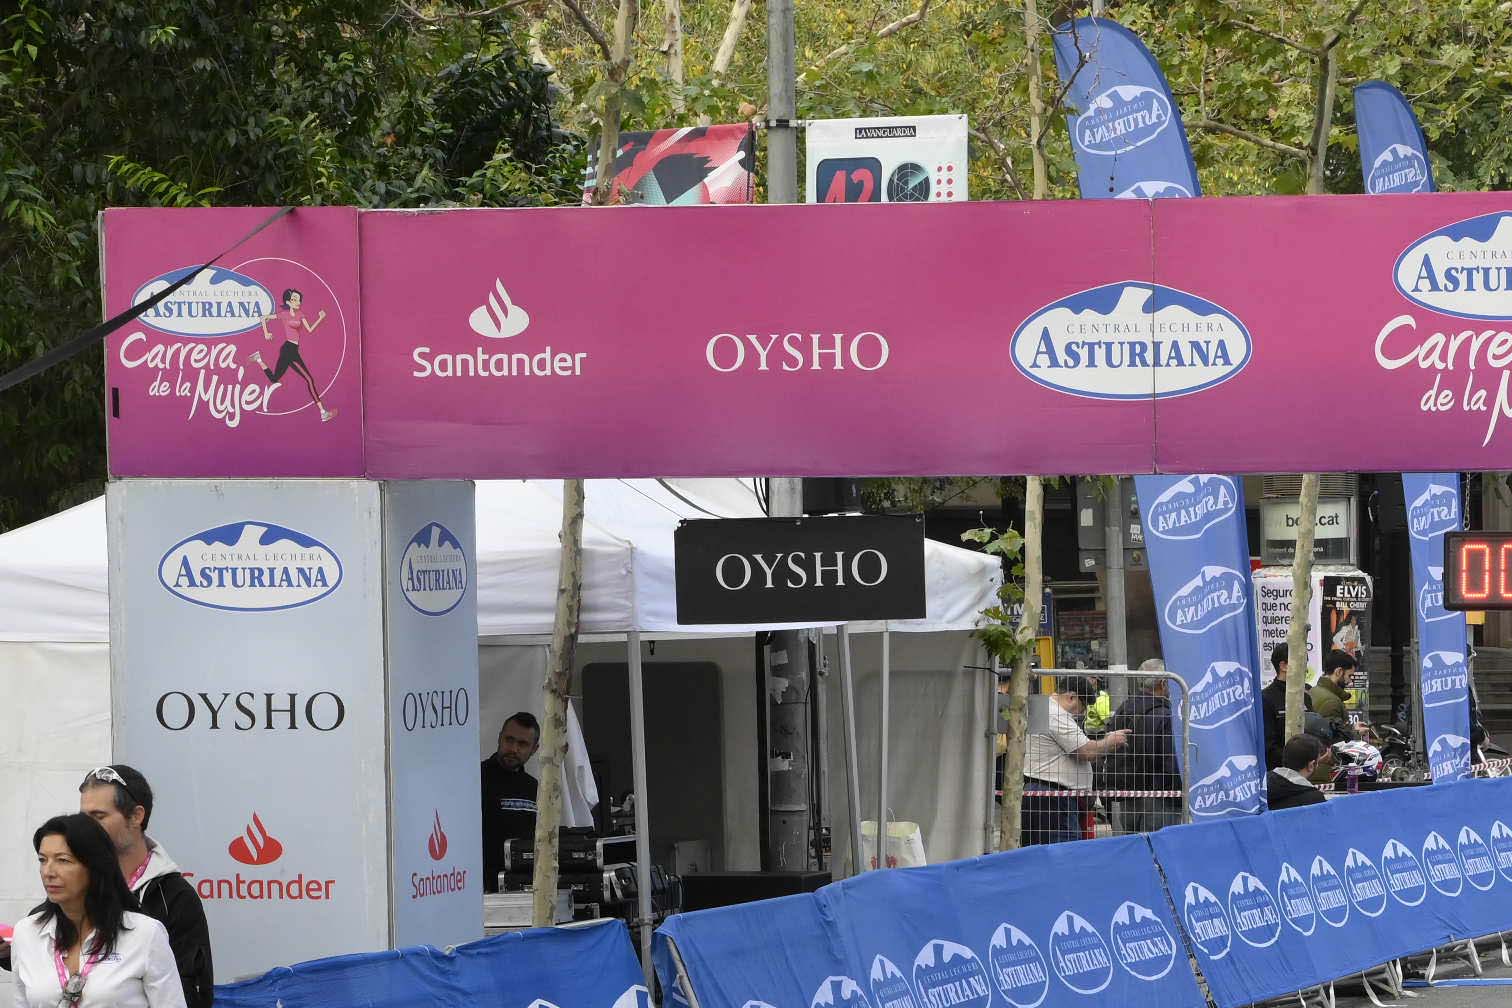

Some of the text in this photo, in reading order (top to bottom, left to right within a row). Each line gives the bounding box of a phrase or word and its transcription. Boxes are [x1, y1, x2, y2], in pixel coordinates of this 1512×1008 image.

[142, 291, 263, 318] ASTURIANA
[171, 288, 208, 298] ENTRAL
[1066, 321, 1225, 334] CENTRAL LECHERA
[120, 332, 236, 371] Carrera
[412, 346, 587, 377] Santander
[704, 332, 890, 372] OYSHO
[1029, 326, 1233, 369] ASTURIANA
[149, 364, 282, 428] de la Mujer
[1420, 373, 1455, 412] de
[1463, 372, 1487, 411] la
[1285, 513, 1340, 528] bc.cat
[172, 554, 330, 589] ASTURIANA
[201, 551, 323, 562] CENTRAL LECHERA
[715, 549, 888, 591] OYSHO
[405, 556, 464, 592] ASTURIANA
[1262, 601, 1279, 613] que
[1336, 586, 1367, 598] ELVIS
[1262, 614, 1293, 627] quiere
[155, 691, 346, 733] OYSHO
[402, 687, 469, 733] OYSHO
[411, 866, 467, 900] Santander
[995, 958, 1046, 990] ASTURIANA
[1056, 945, 1110, 977] ASTURIANA
